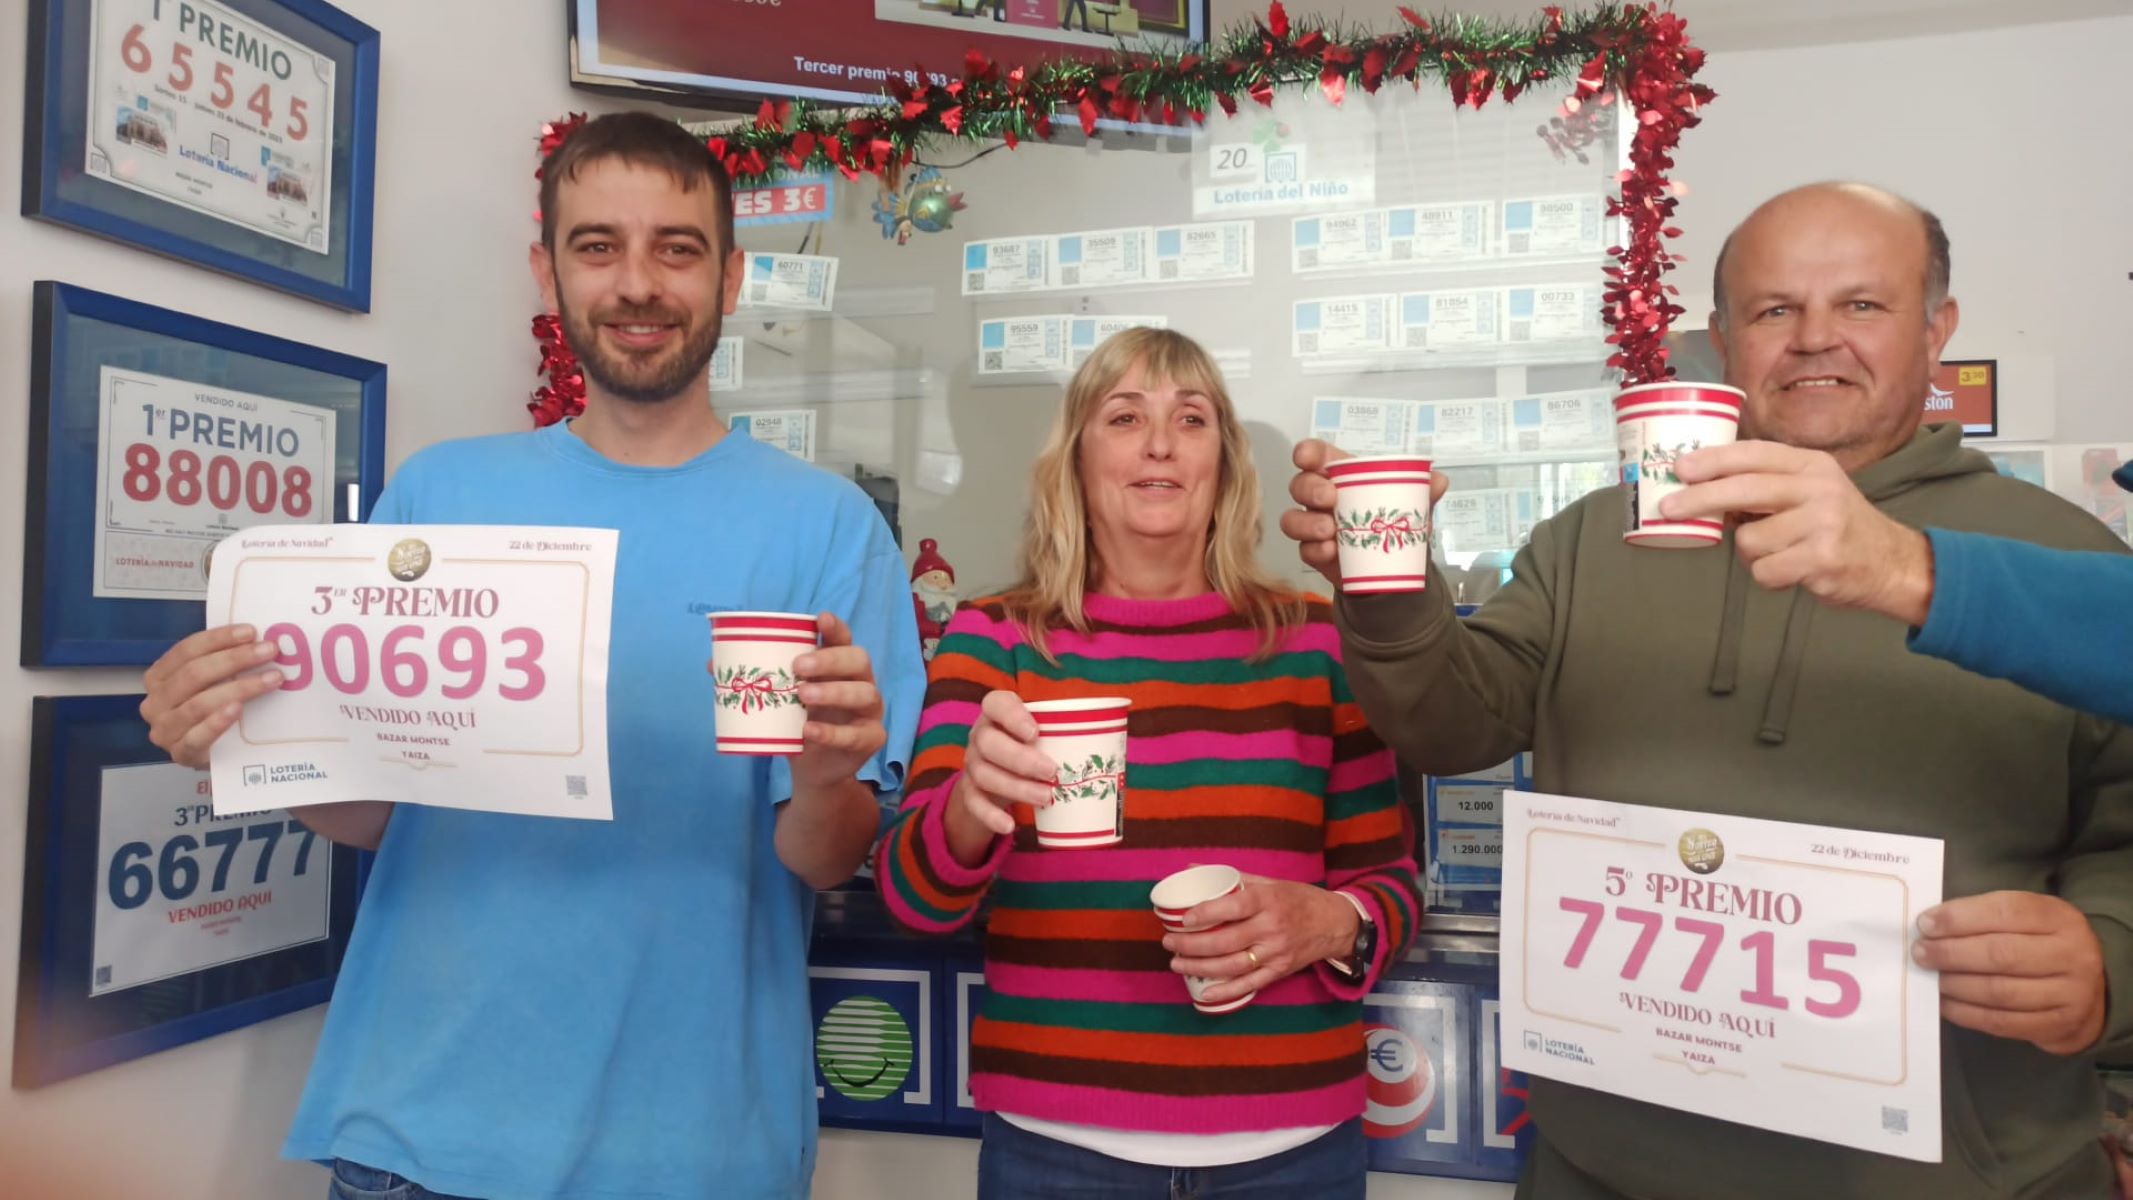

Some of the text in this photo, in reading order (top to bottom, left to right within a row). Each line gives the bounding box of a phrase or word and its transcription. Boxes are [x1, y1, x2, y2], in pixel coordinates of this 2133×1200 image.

[179, 2, 293, 81] PREMIO
[121, 24, 309, 141] 65545
[794, 56, 947, 88] Tercer prem 9093
[1217, 148, 1248, 170] 20
[732, 186, 817, 215] ES 3€
[1278, 183, 1304, 199] del
[1310, 180, 1349, 197] Niño
[194, 393, 235, 408] VENDIDO
[1924, 395, 1953, 411] ston
[170, 408, 300, 458] PREMIO
[123, 443, 312, 518] 88008
[508, 541, 521, 550] 22
[522, 541, 535, 551] de
[352, 586, 499, 618] PREMIO
[263, 622, 546, 701] 90693
[340, 704, 422, 725] VENDIDO
[376, 733, 450, 747] BAZAR MONTSE
[271, 770, 329, 783] NACIONAL
[1458, 801, 1494, 812] 12.000
[108, 821, 317, 910] 66777
[1810, 843, 1911, 864] 22 de Diciembre
[168, 898, 234, 924] VENDIDO
[1645, 872, 1803, 925] PREMIO
[1559, 896, 1862, 1020] 77715
[1619, 991, 1712, 1026] VENDIDO
[1655, 1027, 1743, 1054] BAZAR MONTSE
[1545, 1047, 1595, 1066] NACIONAL
[1681, 1050, 1716, 1065] YAIZA
